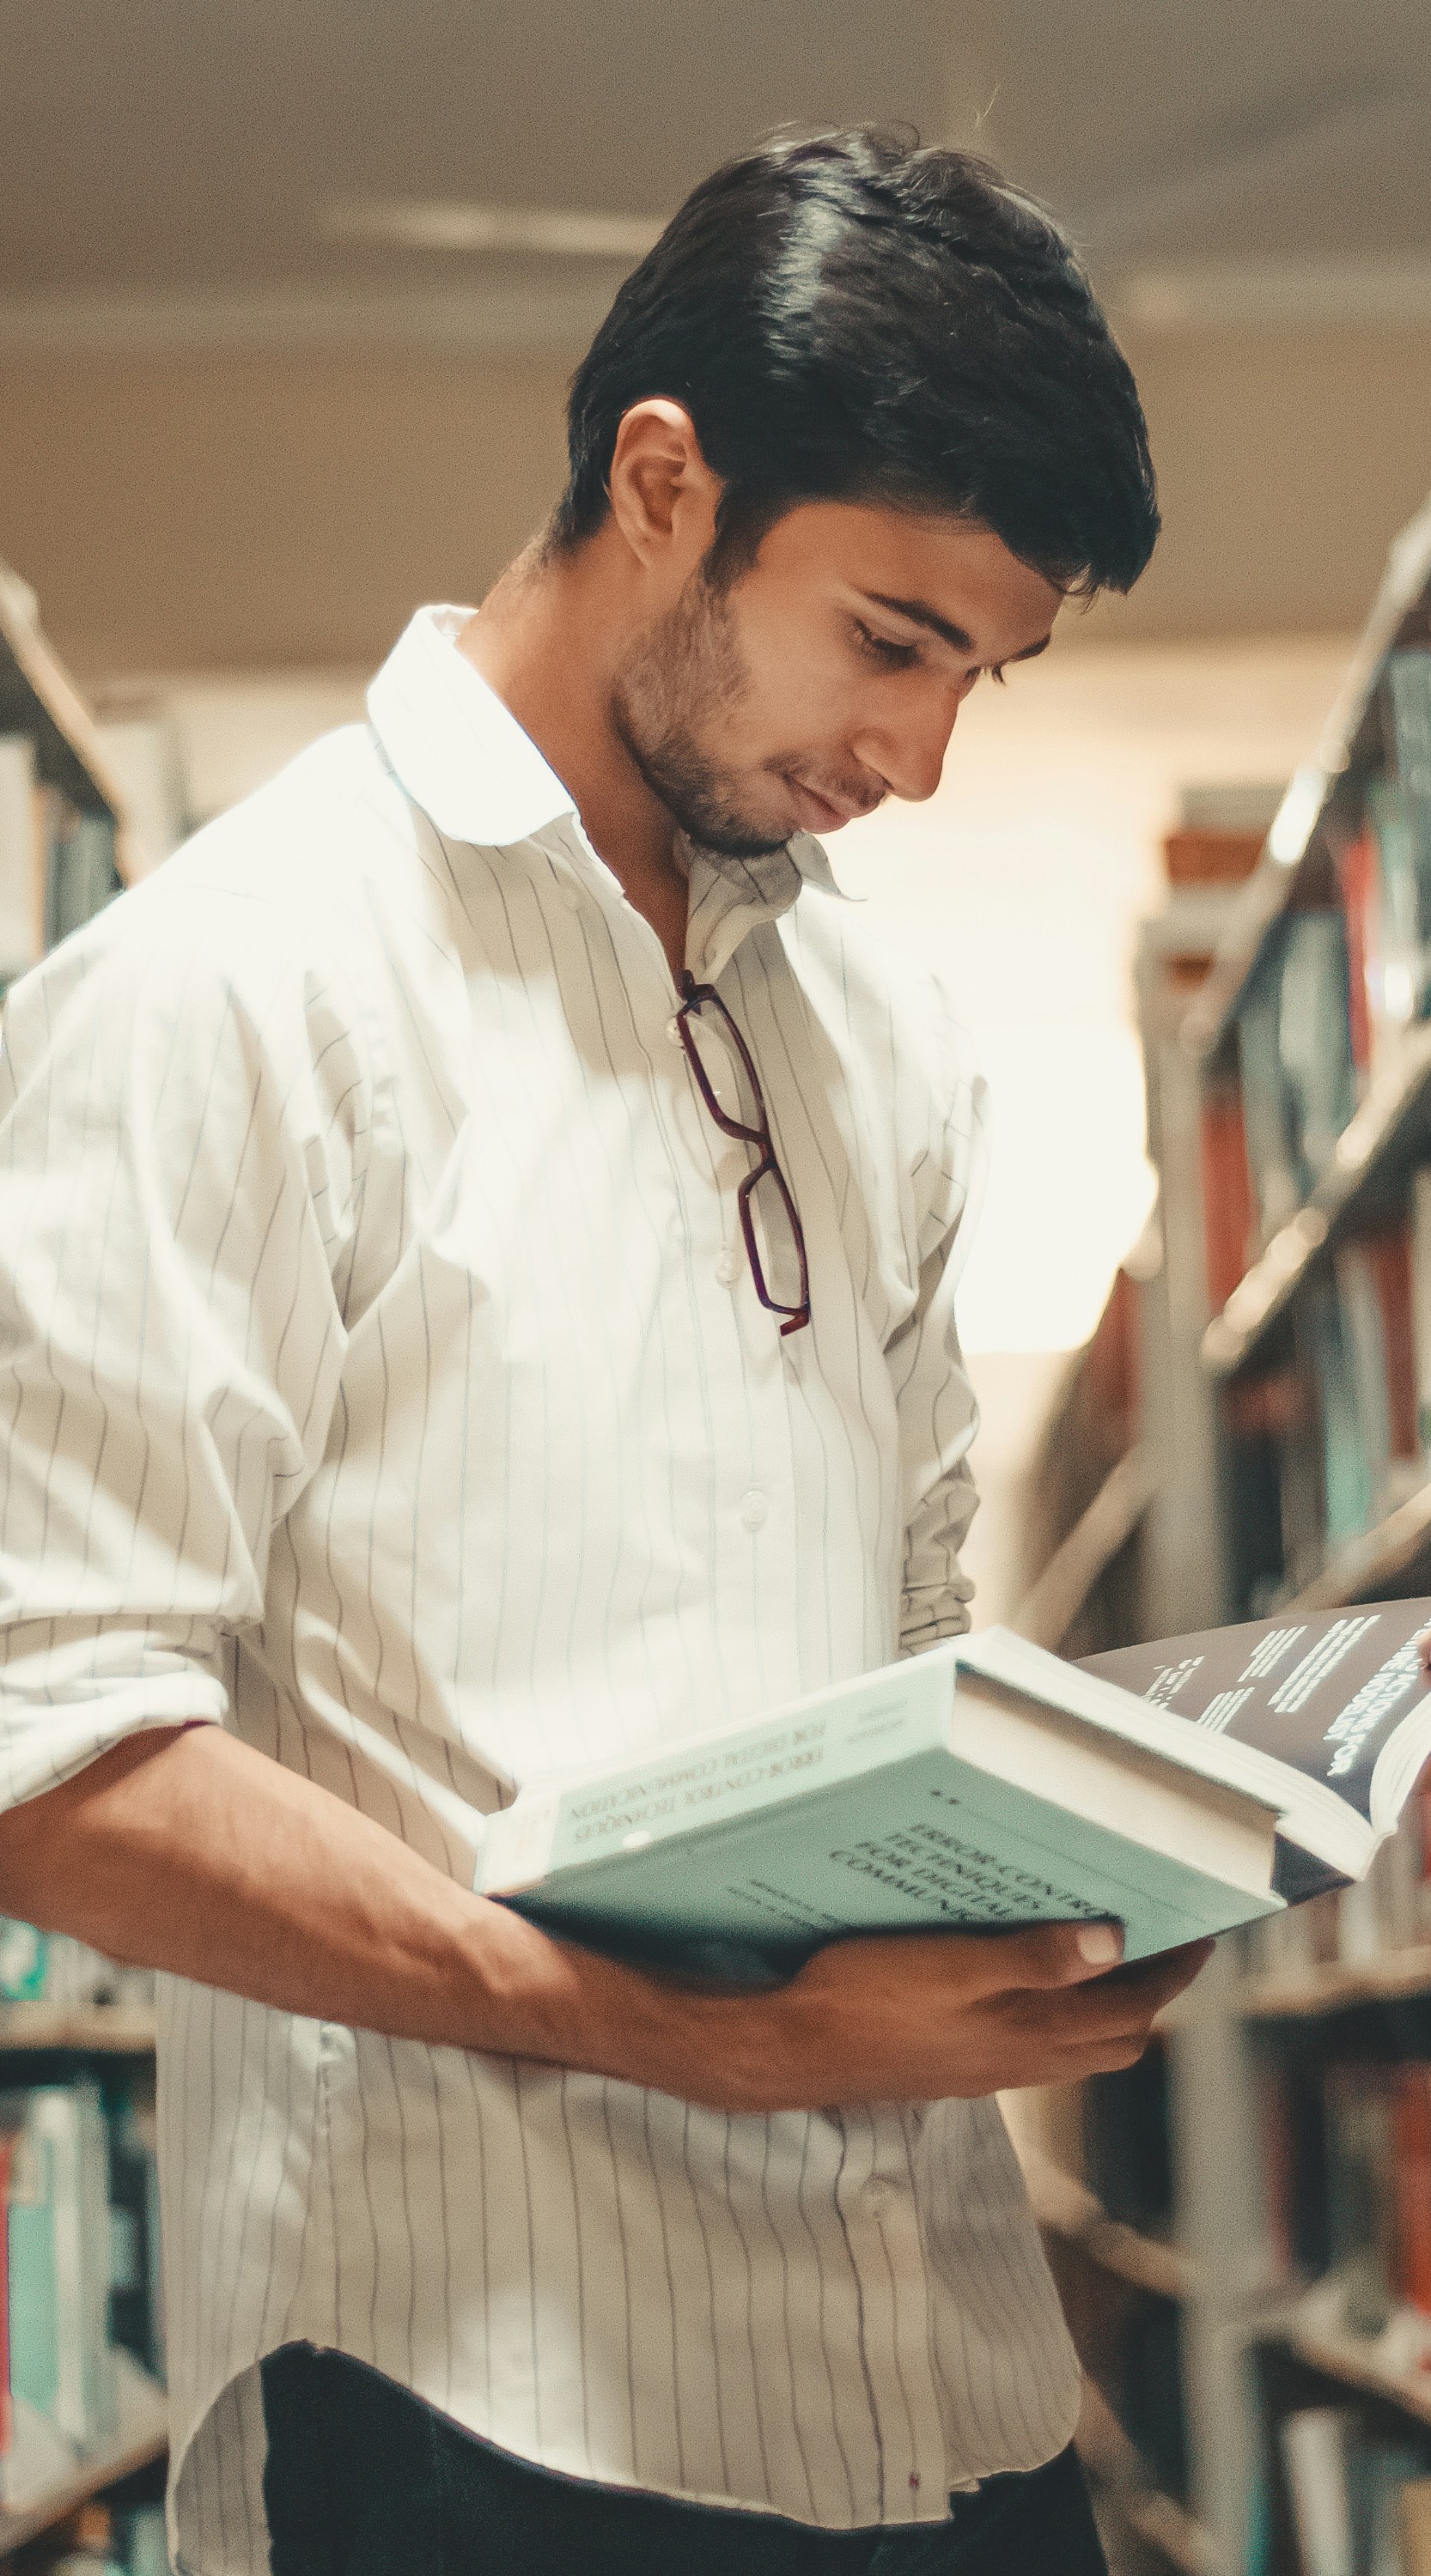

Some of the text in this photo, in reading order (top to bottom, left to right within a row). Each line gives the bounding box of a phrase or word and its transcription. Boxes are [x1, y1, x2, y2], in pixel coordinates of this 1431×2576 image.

[855, 1840, 912, 1868] FOR
[883, 1832, 1045, 1911] TECHNIQUES
[910, 1822, 1111, 1918] ERROR-CONTRO
[912, 1867, 1013, 1917] DIGITAL
